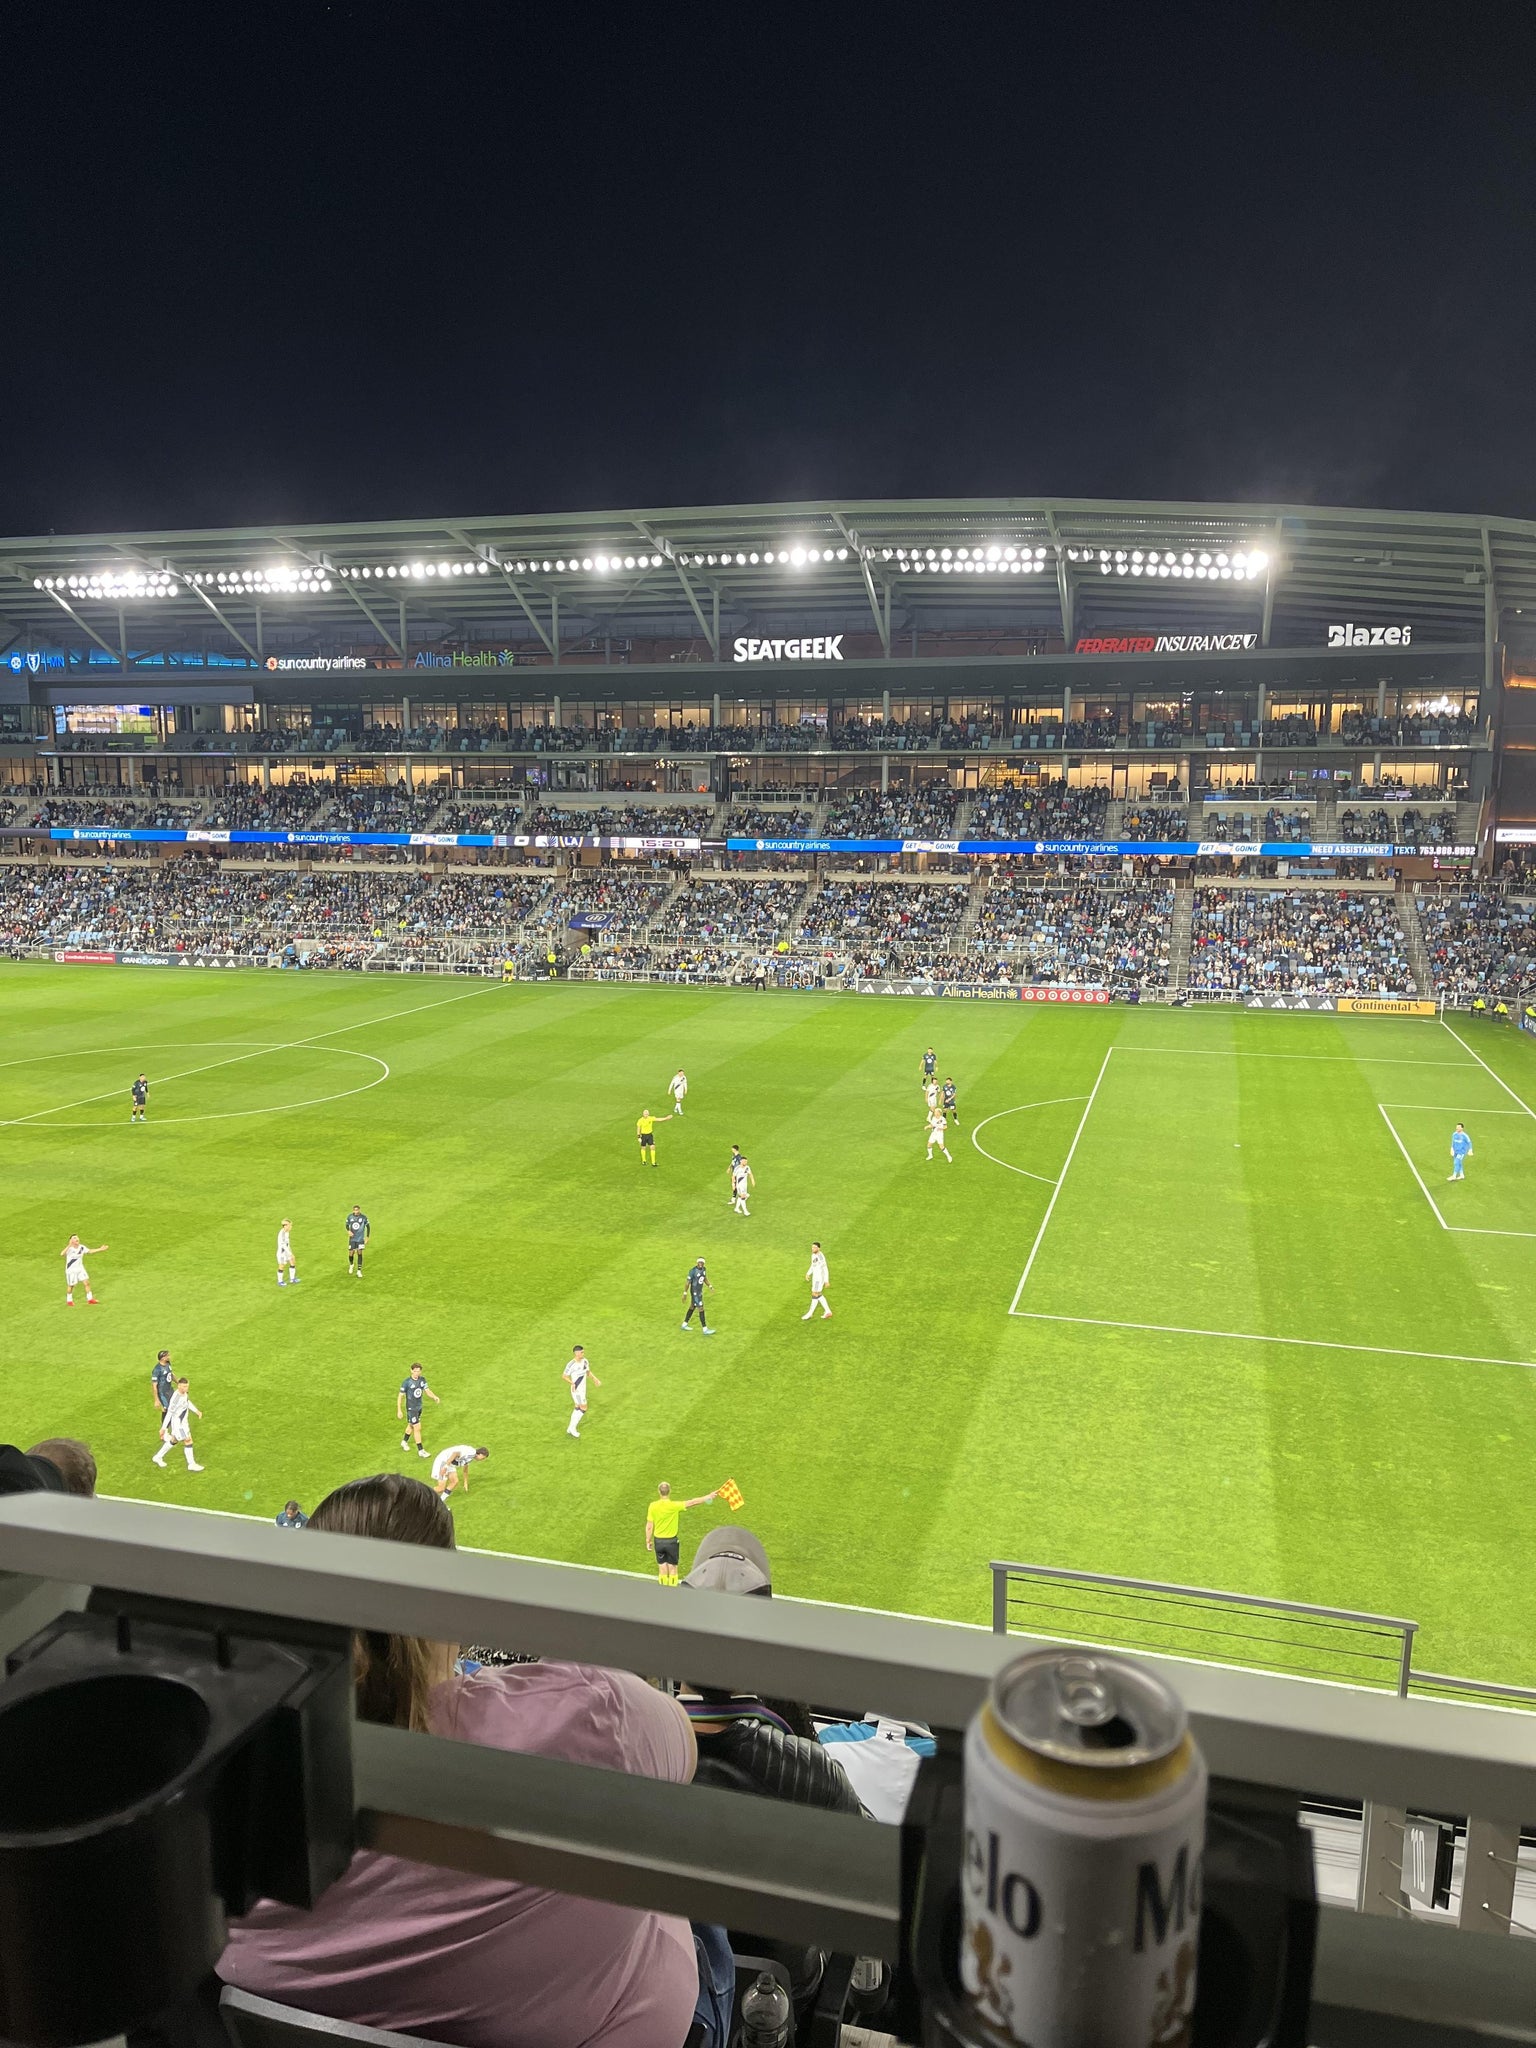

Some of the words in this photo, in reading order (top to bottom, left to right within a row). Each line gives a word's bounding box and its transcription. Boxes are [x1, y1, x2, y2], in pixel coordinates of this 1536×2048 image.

[1327, 623, 1401, 647] Blaze
[733, 634, 844, 662] SEATGEEK
[1075, 636, 1155, 654] FEDERATED
[1154, 634, 1243, 652] INSURANCE
[278, 659, 295, 669] sun
[295, 656, 331, 671] country
[332, 655, 366, 669] airlines
[640, 839, 685, 848] 15:20
[805, 841, 830, 850] airlines
[1090, 843, 1118, 852] airlines
[1311, 845, 1333, 854] NEED
[1334, 845, 1389, 855] ASSISTANCE?
[1394, 846, 1417, 855] TEXT:
[1351, 1000, 1411, 1012] Continental
[1410, 1827, 1426, 1893] 110
